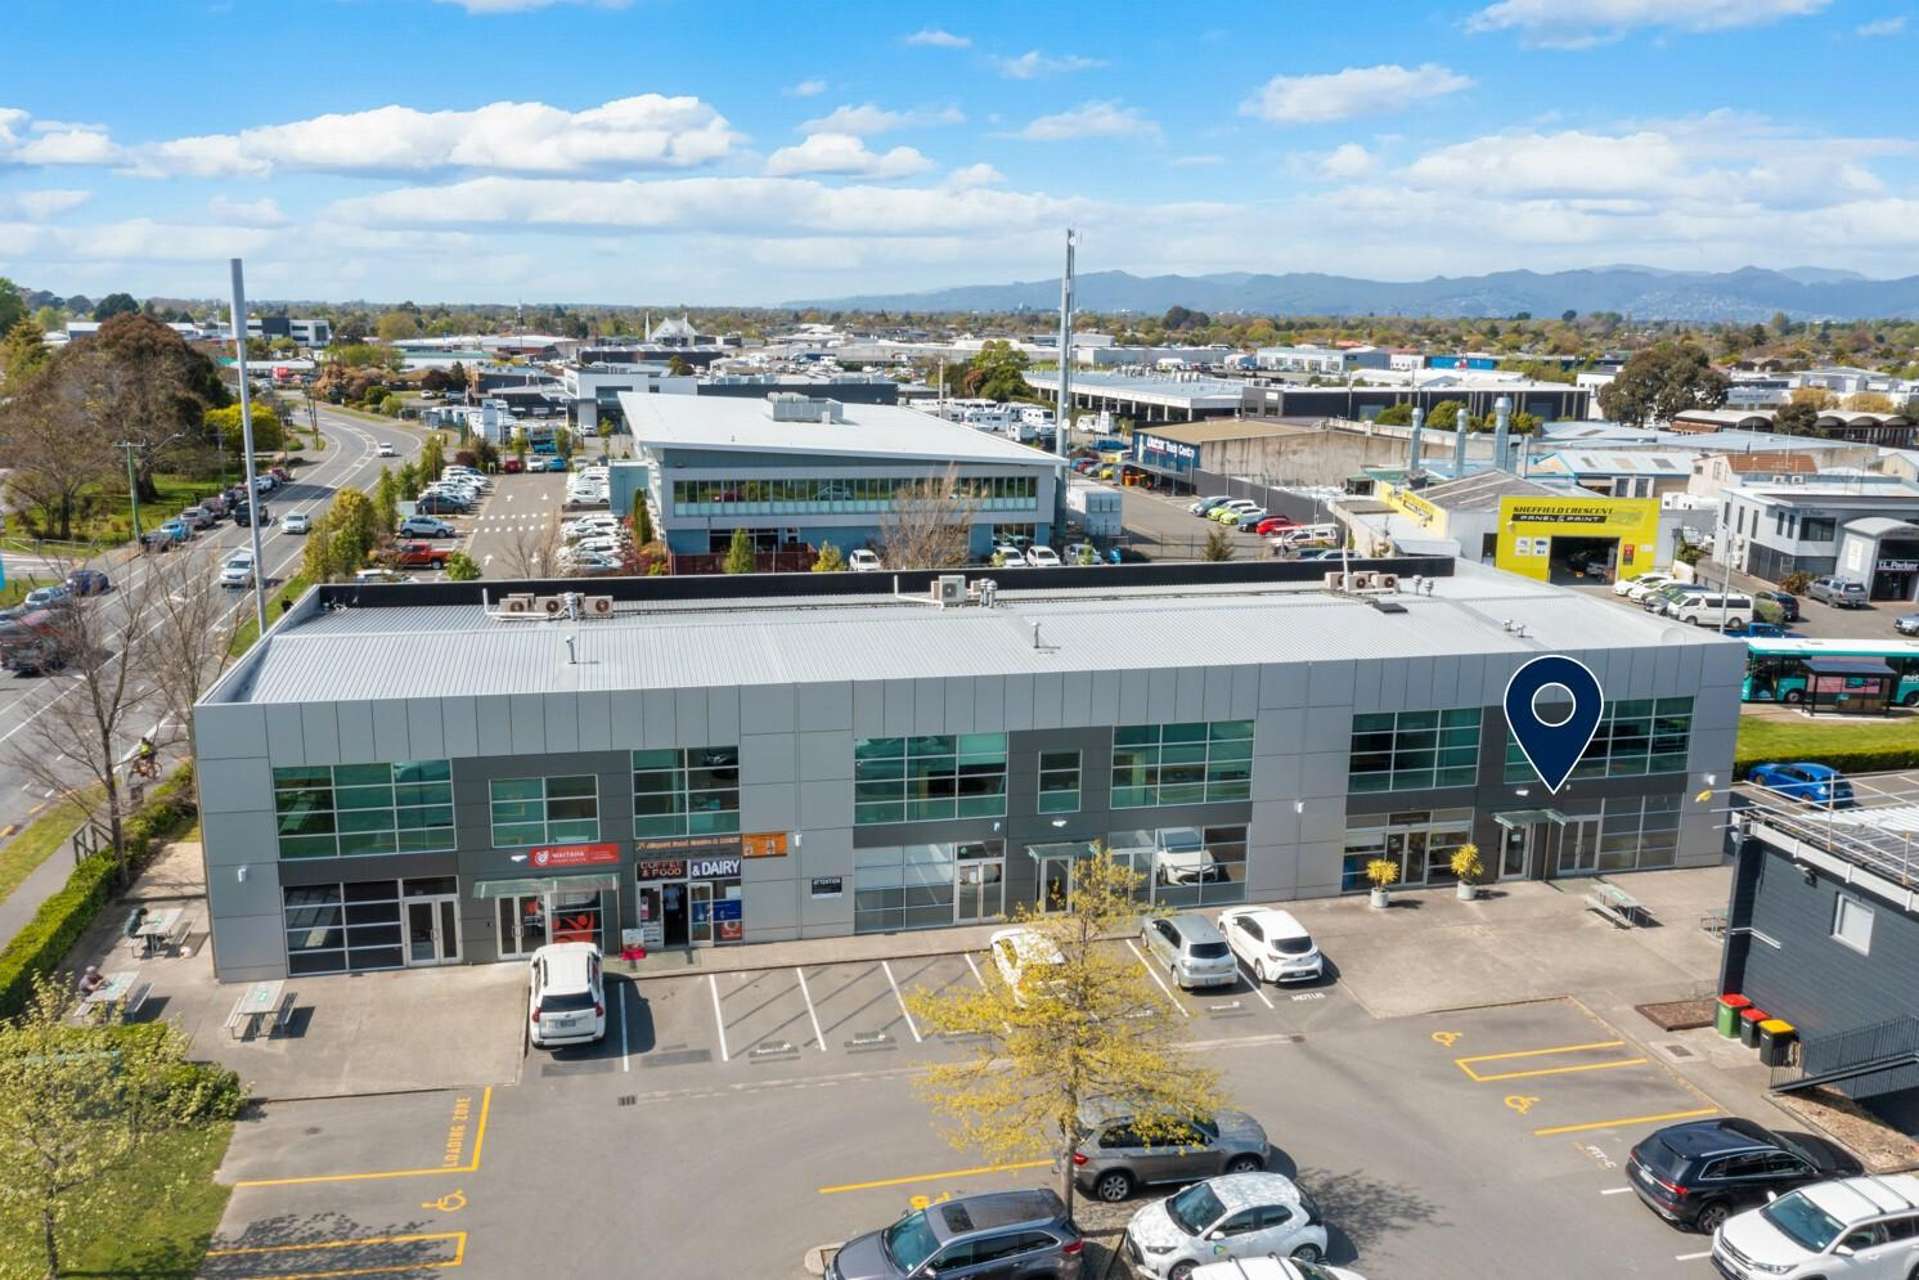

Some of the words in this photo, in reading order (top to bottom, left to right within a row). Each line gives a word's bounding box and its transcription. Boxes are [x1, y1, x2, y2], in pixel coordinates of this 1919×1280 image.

[1513, 506, 1563, 514] SHEFFIELD
[651, 867, 682, 877] FOOD
[692, 864, 700, 877] &
[701, 859, 740, 876] DAIRY
[452, 1096, 472, 1121] ZONE
[442, 1125, 466, 1168] LOADING
